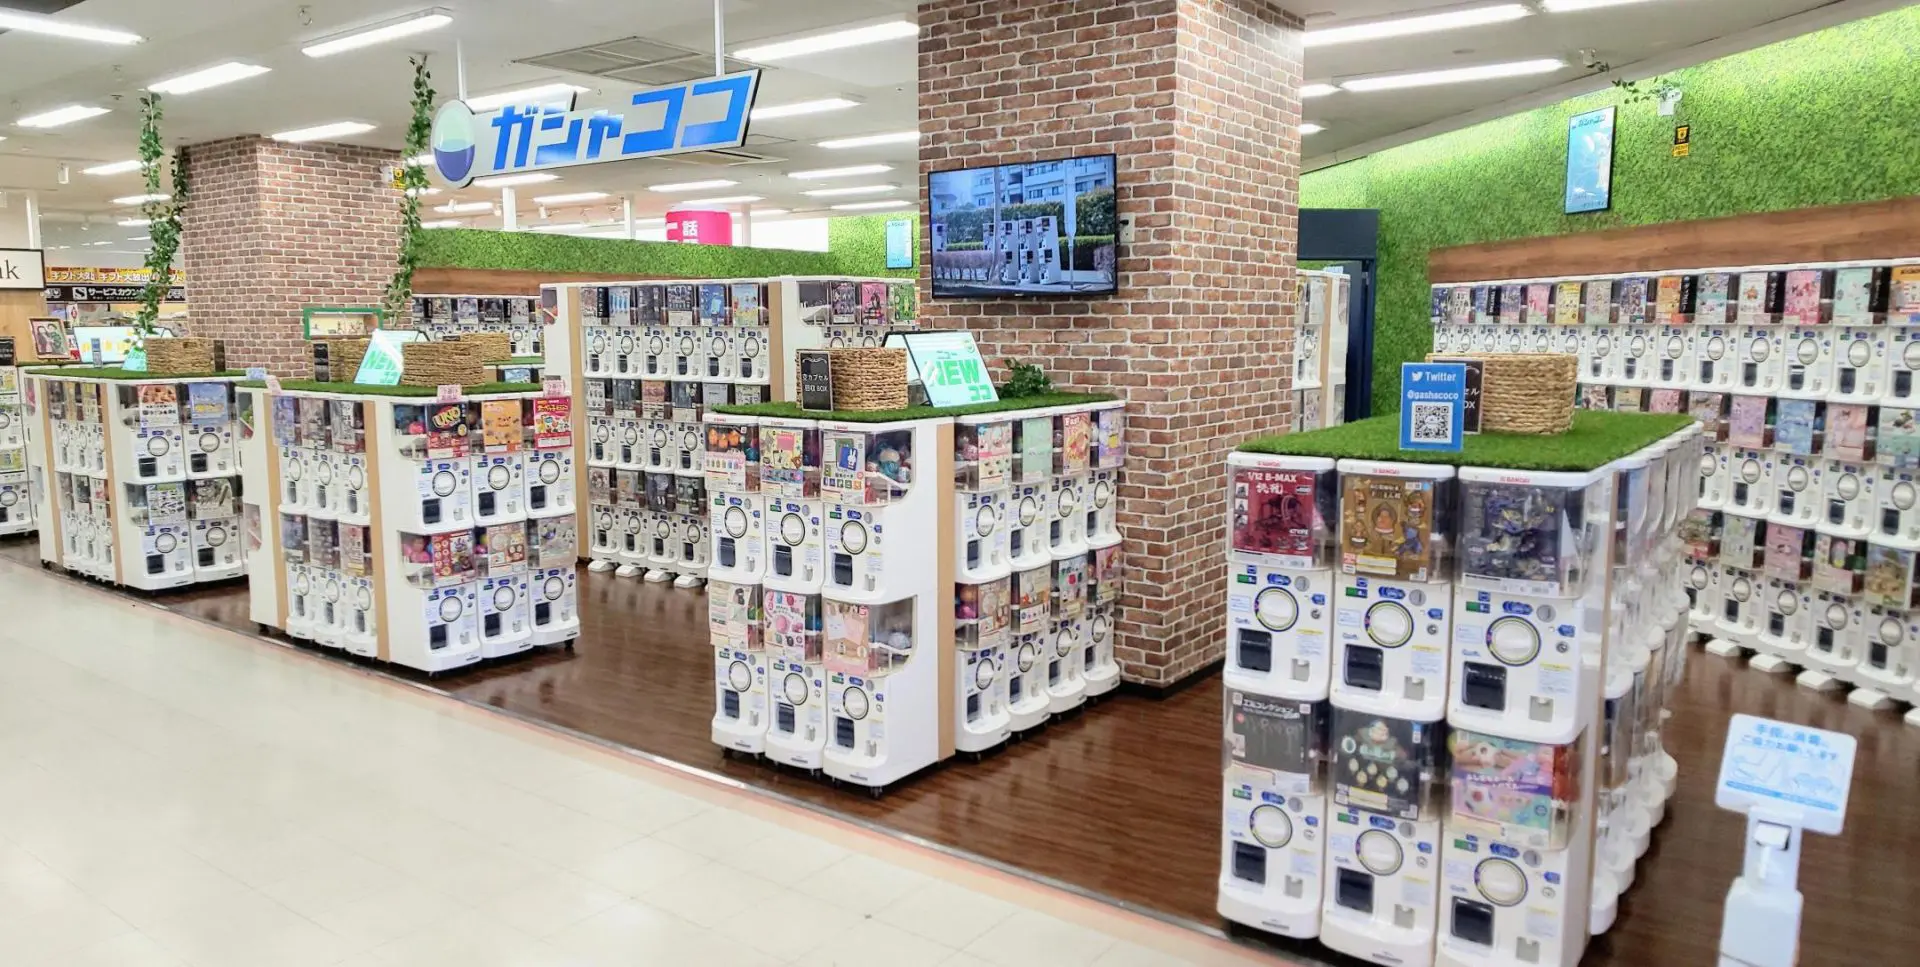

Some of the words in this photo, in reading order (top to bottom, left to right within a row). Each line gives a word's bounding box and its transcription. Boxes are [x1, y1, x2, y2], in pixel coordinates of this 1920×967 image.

[490, 75, 752, 171] ガシャココ
[0, 259, 20, 280] k
[921, 358, 980, 387] NEW
[1425, 371, 1457, 382] Twitter
[1407, 388, 1460, 401] @gashacoco
[436, 405, 461, 426] UNO
[1265, 473, 1297, 483] B-MAX
